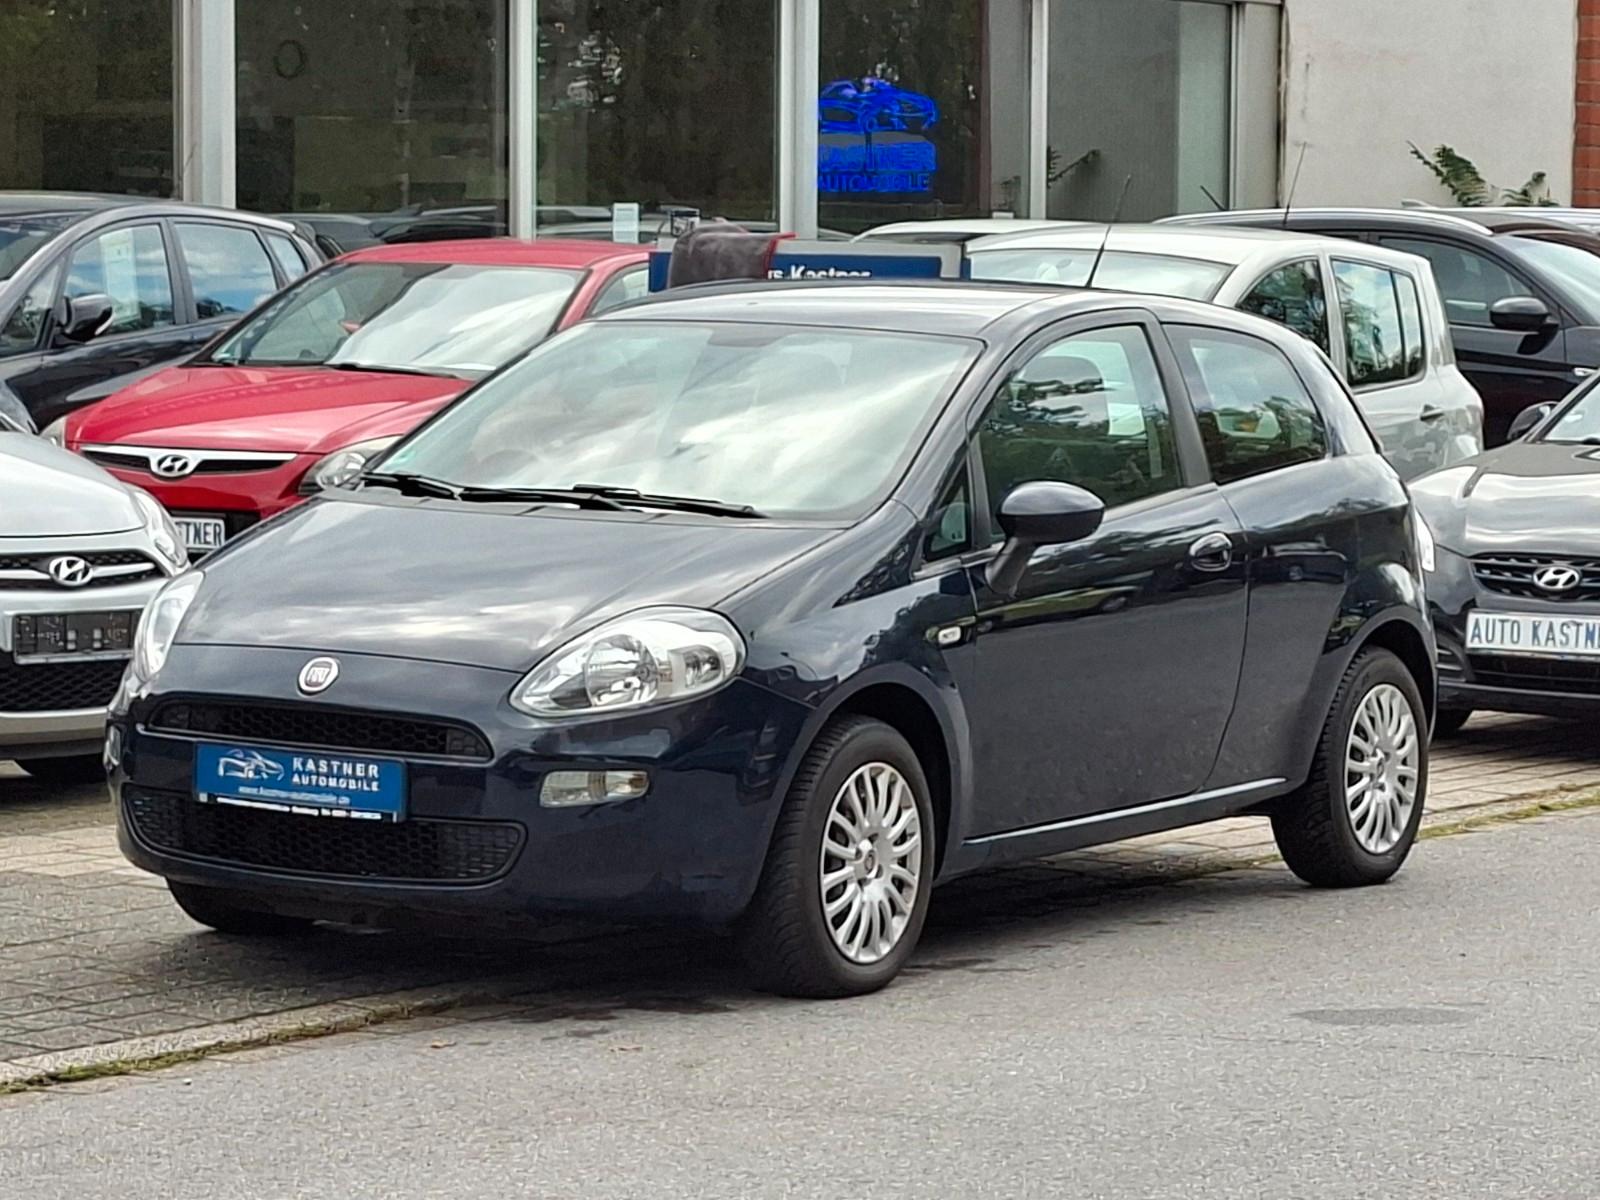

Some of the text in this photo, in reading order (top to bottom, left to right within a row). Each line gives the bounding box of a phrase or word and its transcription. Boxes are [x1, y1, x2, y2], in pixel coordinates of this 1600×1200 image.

[1470, 617, 1600, 649] AUTO KASTN
[292, 757, 380, 778] KASTNER
[292, 773, 380, 792] AUTOMOBILE
